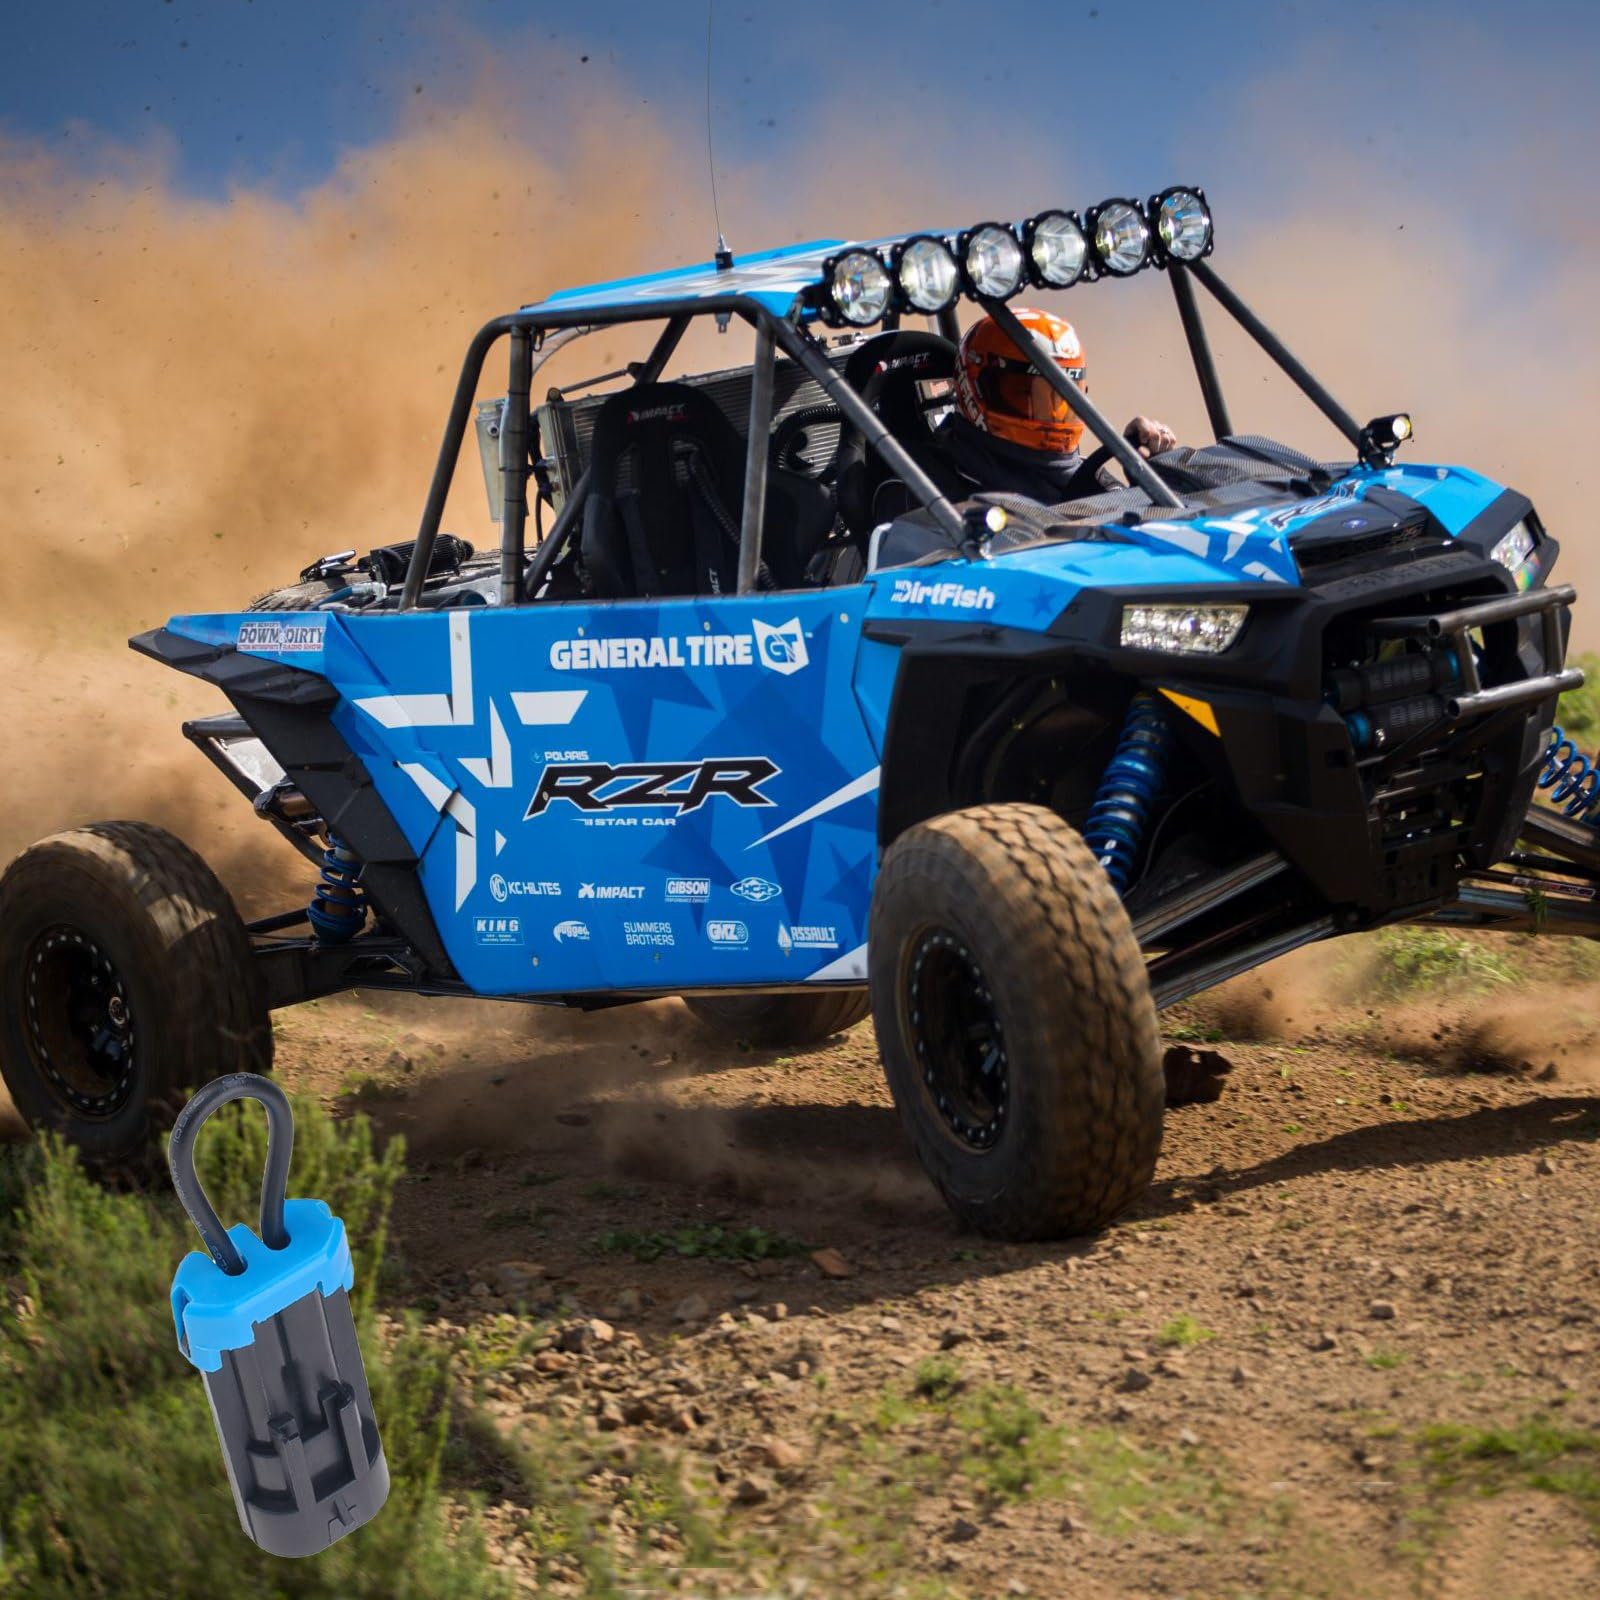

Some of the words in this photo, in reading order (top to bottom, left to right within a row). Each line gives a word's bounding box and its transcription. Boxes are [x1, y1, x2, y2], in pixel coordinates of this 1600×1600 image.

[890, 579, 996, 610] DirtFish
[239, 628, 279, 643] DOWN
[287, 627, 324, 643] DIRTY
[549, 637, 686, 671] GENERAL
[686, 634, 754, 666] TIRE
[544, 750, 590, 761] POLARIS
[522, 756, 783, 821] RZR
[594, 817, 638, 826] STAR
[642, 817, 677, 826] CAR
[507, 881, 522, 895] KC
[596, 886, 646, 899] IMPACT
[668, 882, 708, 895] GIBSON
[476, 919, 519, 932] KING
[623, 922, 672, 934] SUMMERS
[626, 934, 675, 946] BROTHERS
[790, 926, 836, 942] ASSAULT
